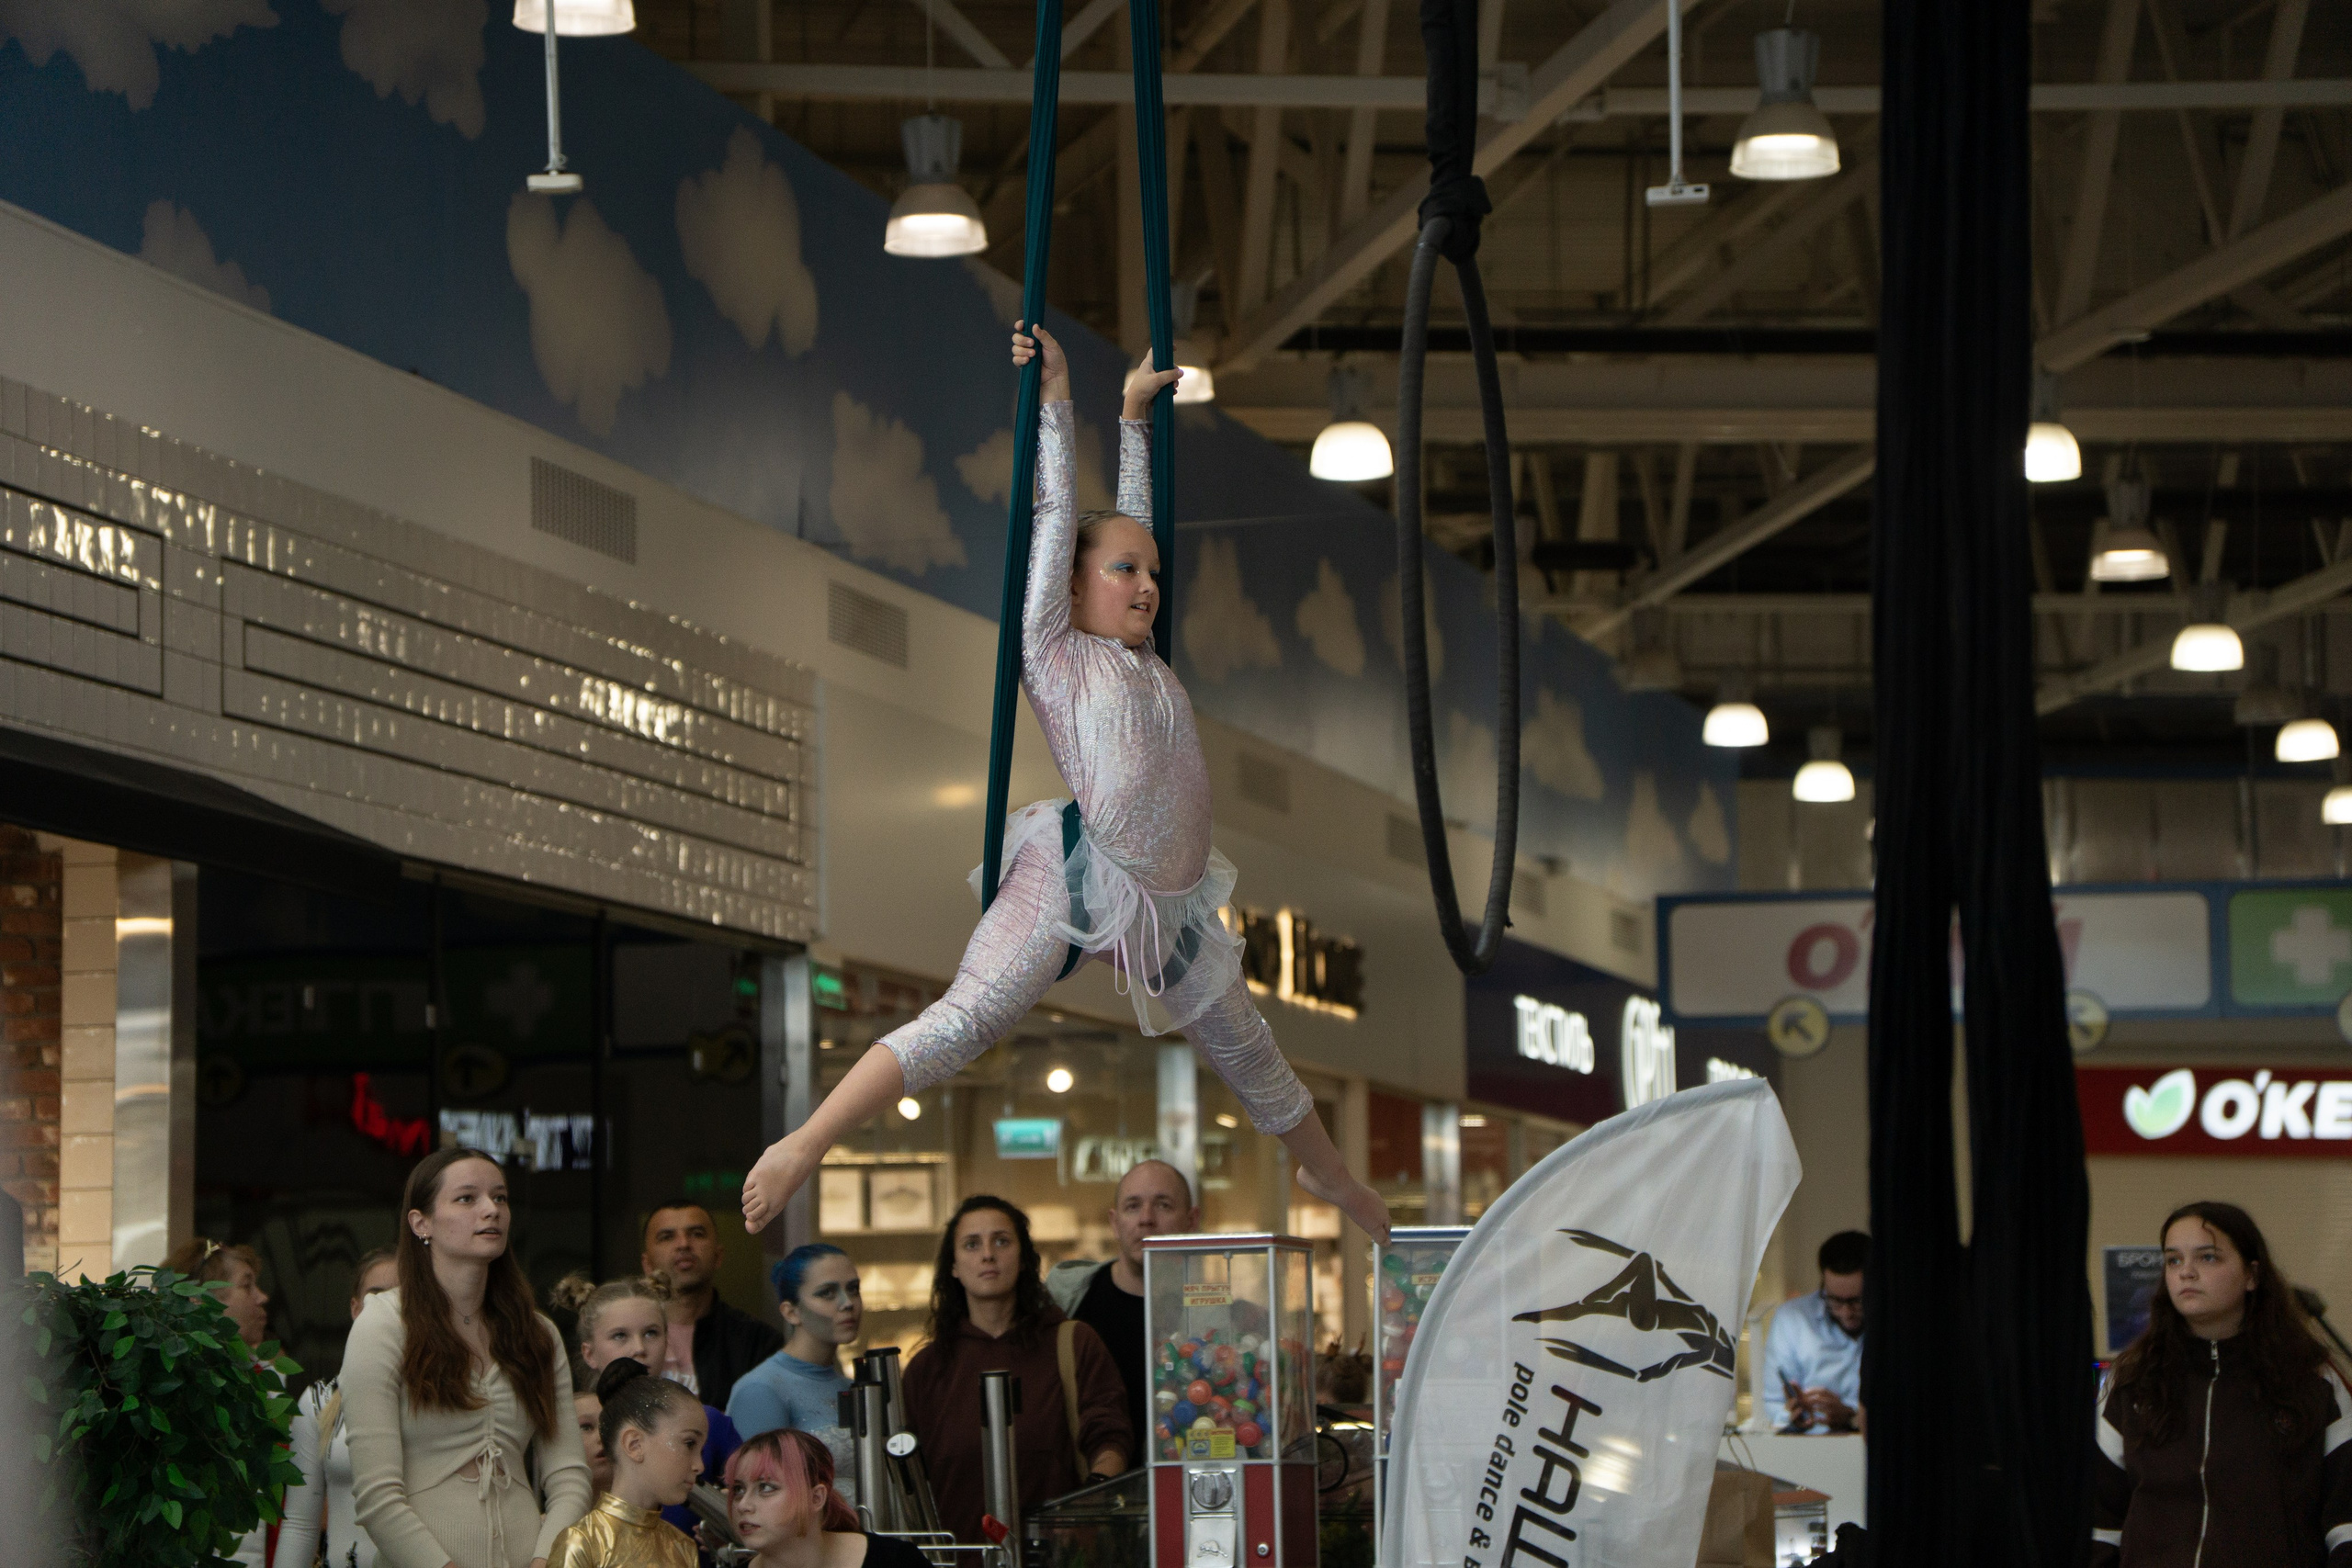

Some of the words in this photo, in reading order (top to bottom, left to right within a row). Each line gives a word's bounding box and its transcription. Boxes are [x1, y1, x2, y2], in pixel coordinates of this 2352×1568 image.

[1501, 1361, 1535, 1428] pole
[1476, 1433, 1516, 1522] dance
[1469, 1527, 1491, 1550] &
